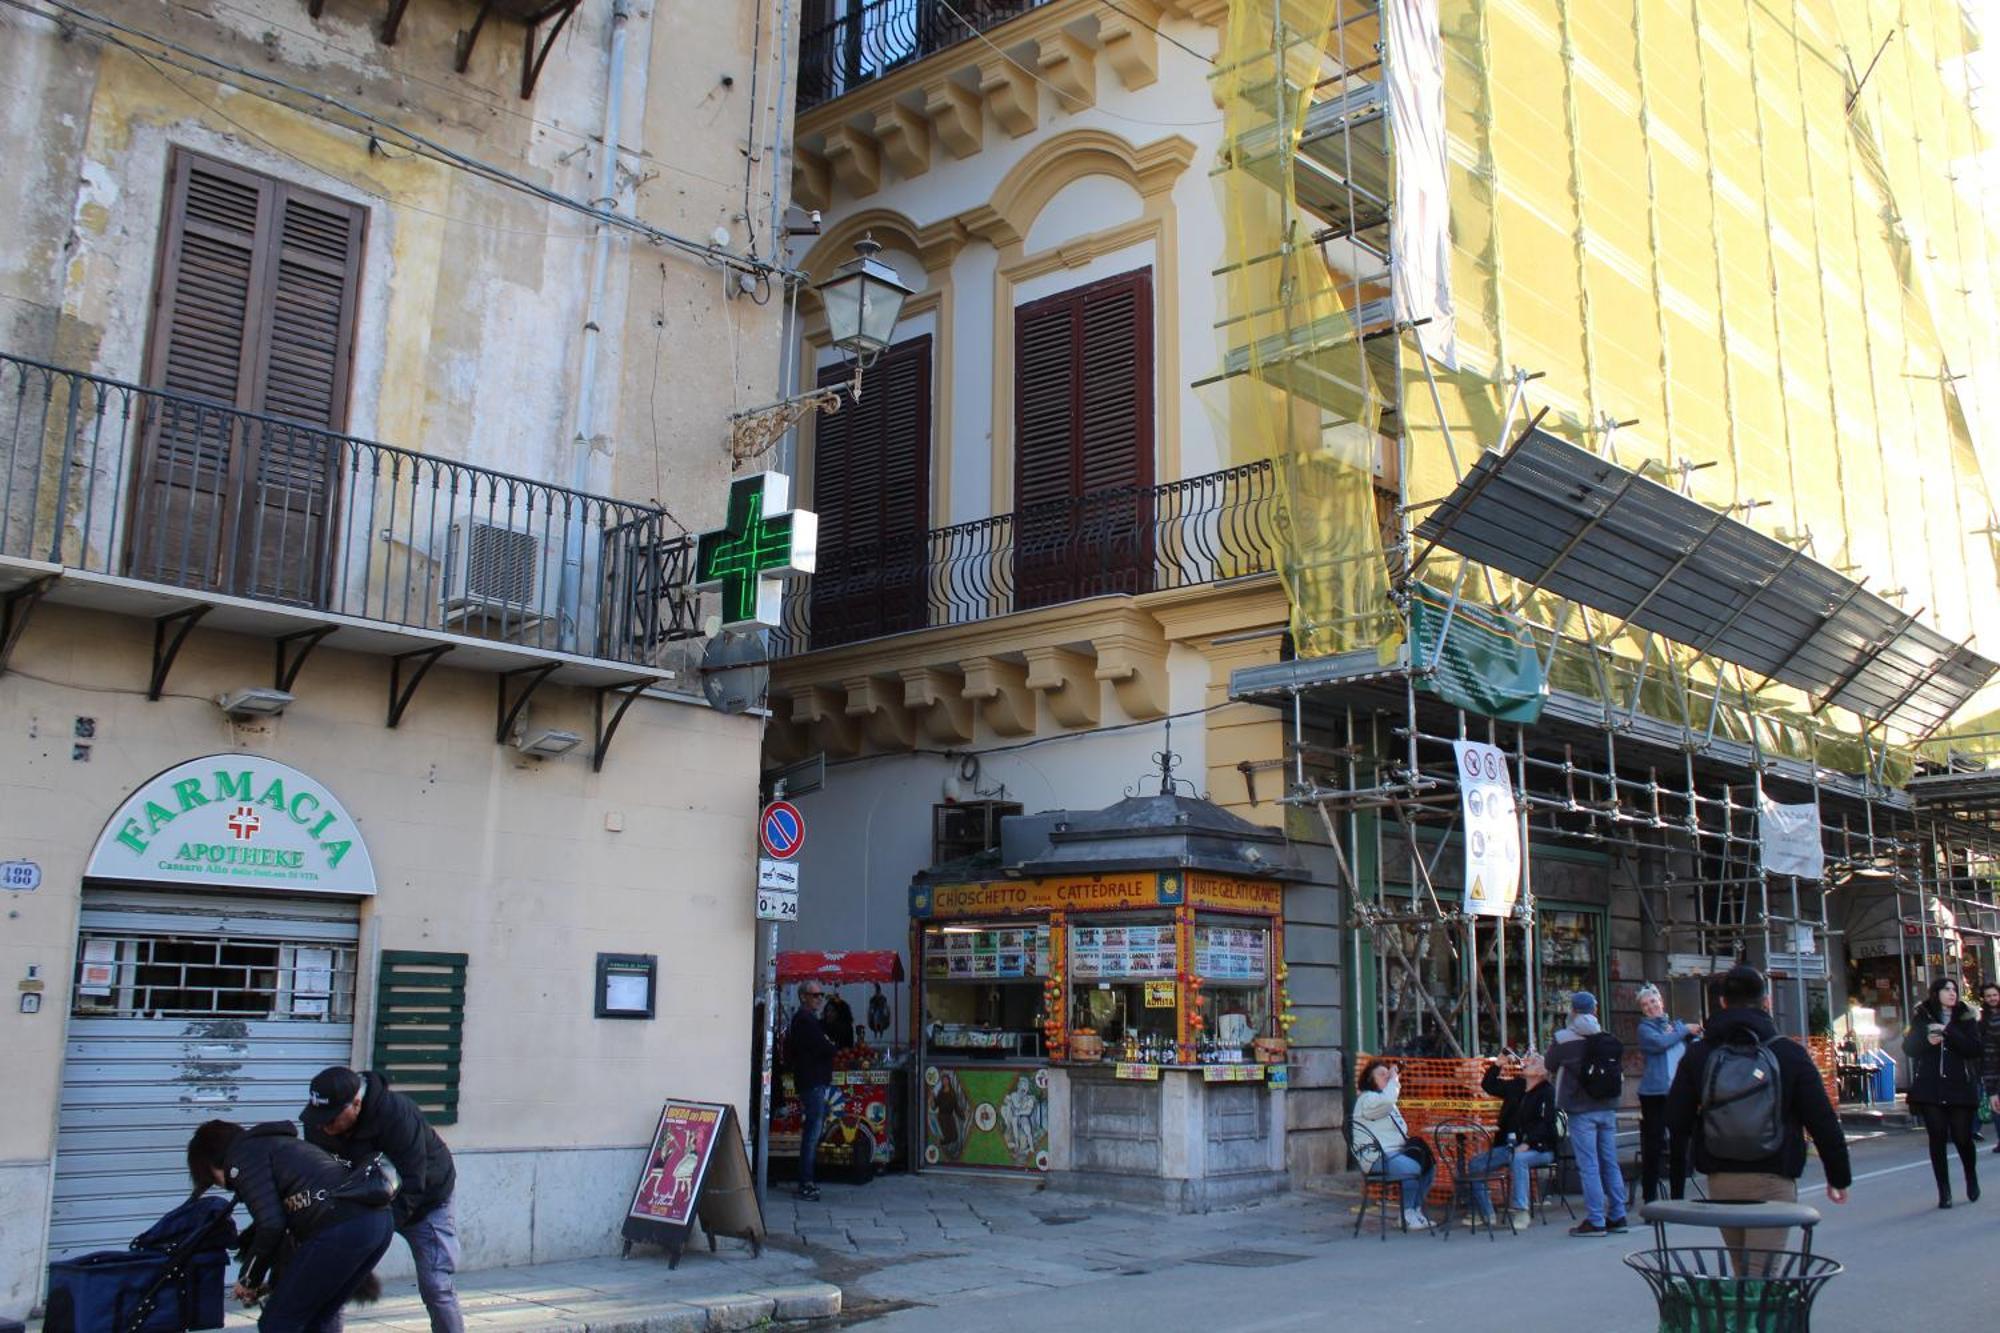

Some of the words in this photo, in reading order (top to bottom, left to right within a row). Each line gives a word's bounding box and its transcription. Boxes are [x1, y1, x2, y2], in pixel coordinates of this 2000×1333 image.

[113, 769, 353, 870] FARMACIA
[176, 841, 305, 868] APOTHEKE
[760, 900, 768, 911] 0
[782, 902, 796, 914] 24
[936, 887, 1027, 907] CHIOSCHETTO
[1056, 880, 1143, 900] CATTEDRALE
